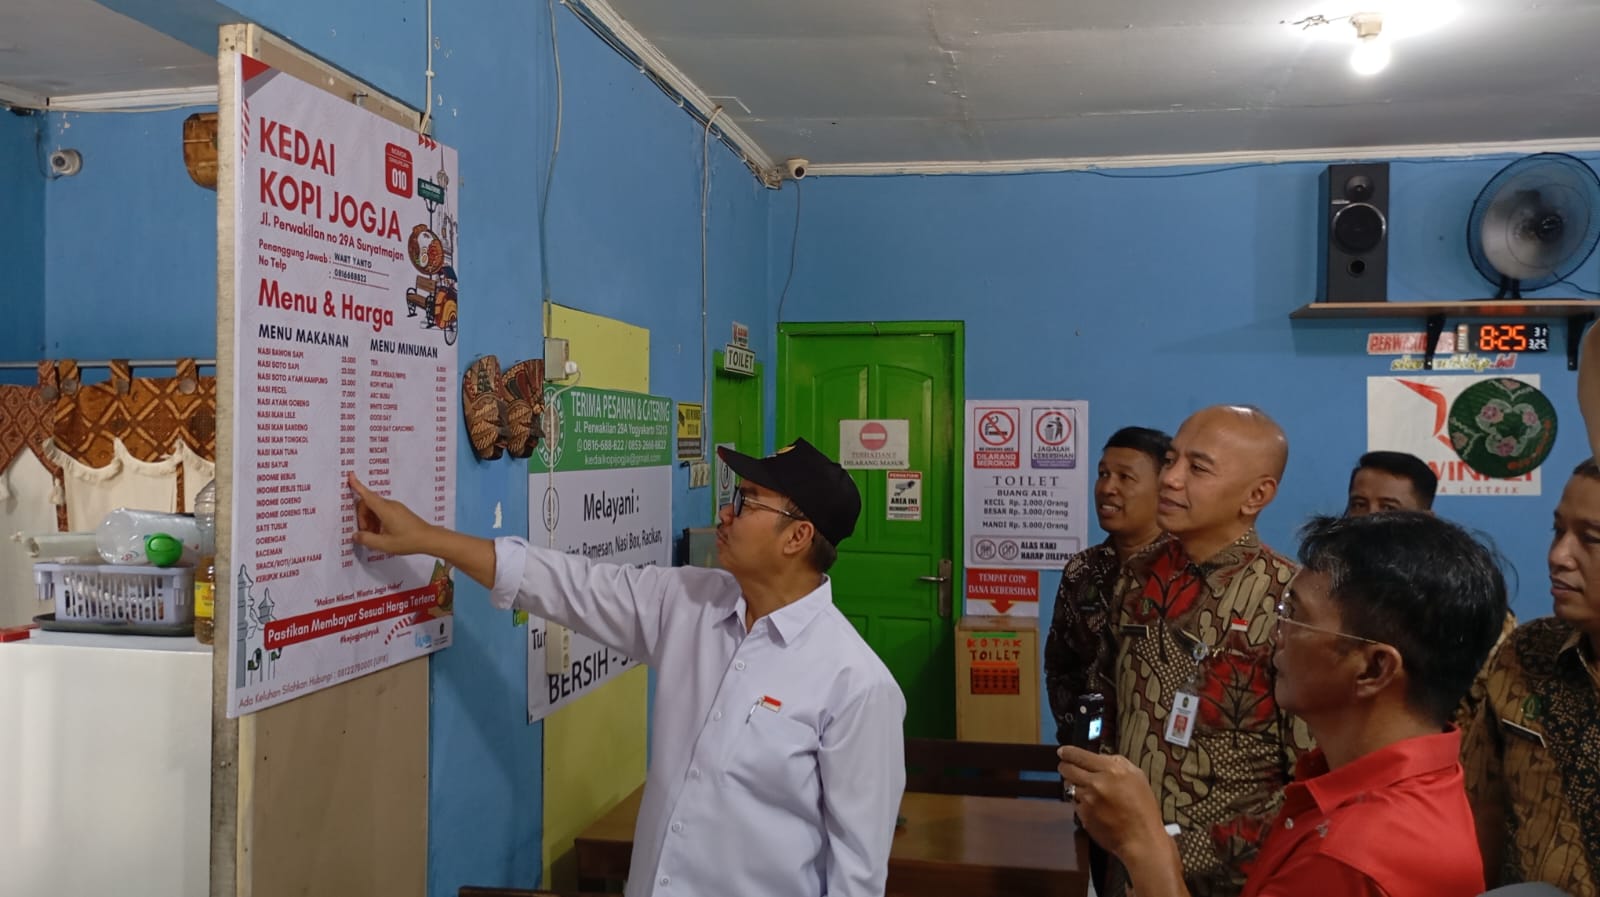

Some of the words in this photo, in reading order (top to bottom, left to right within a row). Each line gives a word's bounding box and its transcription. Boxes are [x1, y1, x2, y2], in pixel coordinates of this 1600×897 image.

[259, 116, 335, 177] KEDAI
[392, 167, 407, 191] 010
[259, 167, 322, 219] KOPI
[329, 191, 402, 242] JOGJA
[259, 212, 271, 227] Jl.
[273, 216, 325, 242] Perwakilan
[326, 232, 337, 243] no
[338, 232, 355, 249] 29A
[356, 238, 404, 264] Suryatmajan
[258, 239, 305, 261] Penanggung
[306, 250, 329, 263] Jawab
[352, 256, 372, 268] YANTO
[258, 254, 269, 267] No
[270, 256, 287, 271] Telp
[258, 278, 317, 314] Menu
[322, 290, 336, 318] &
[342, 293, 394, 332] Harga
[258, 323, 293, 340] MENU
[295, 326, 349, 348] MAKANAN
[1480, 325, 1526, 350] 8:25
[370, 338, 396, 354] MENU
[397, 343, 438, 358] MINUMAN
[728, 350, 754, 370] TOILET
[571, 391, 601, 418] TERIMA
[602, 394, 636, 419] PESANAN
[642, 399, 670, 422] CATERING
[583, 421, 616, 434] Perwakilan
[992, 475, 1059, 486] TOILET
[1460, 486, 1519, 494] LISTRIK
[583, 489, 634, 524] Melayani
[1008, 500, 1020, 508] Rp.
[1008, 522, 1020, 530] Rp.
[582, 542, 614, 558] Ramesan,
[615, 535, 628, 553] Nasi
[629, 533, 641, 550] Box,
[1021, 542, 1038, 550] ALAS
[1039, 542, 1057, 550] KAKI
[1021, 552, 1044, 560] HARAP
[978, 573, 1007, 582] TEMPAT
[1008, 574, 1028, 583] COIN
[968, 584, 989, 593] DANA
[990, 584, 1036, 596] KEBERSIHAN
[267, 624, 309, 643] Pastikan
[311, 613, 357, 632] Membayar
[358, 603, 385, 620] Sesuai
[386, 599, 408, 614] Harga
[410, 594, 436, 607] Tertera
[969, 650, 1021, 660] TOILET
[549, 647, 609, 705] BERSIH
